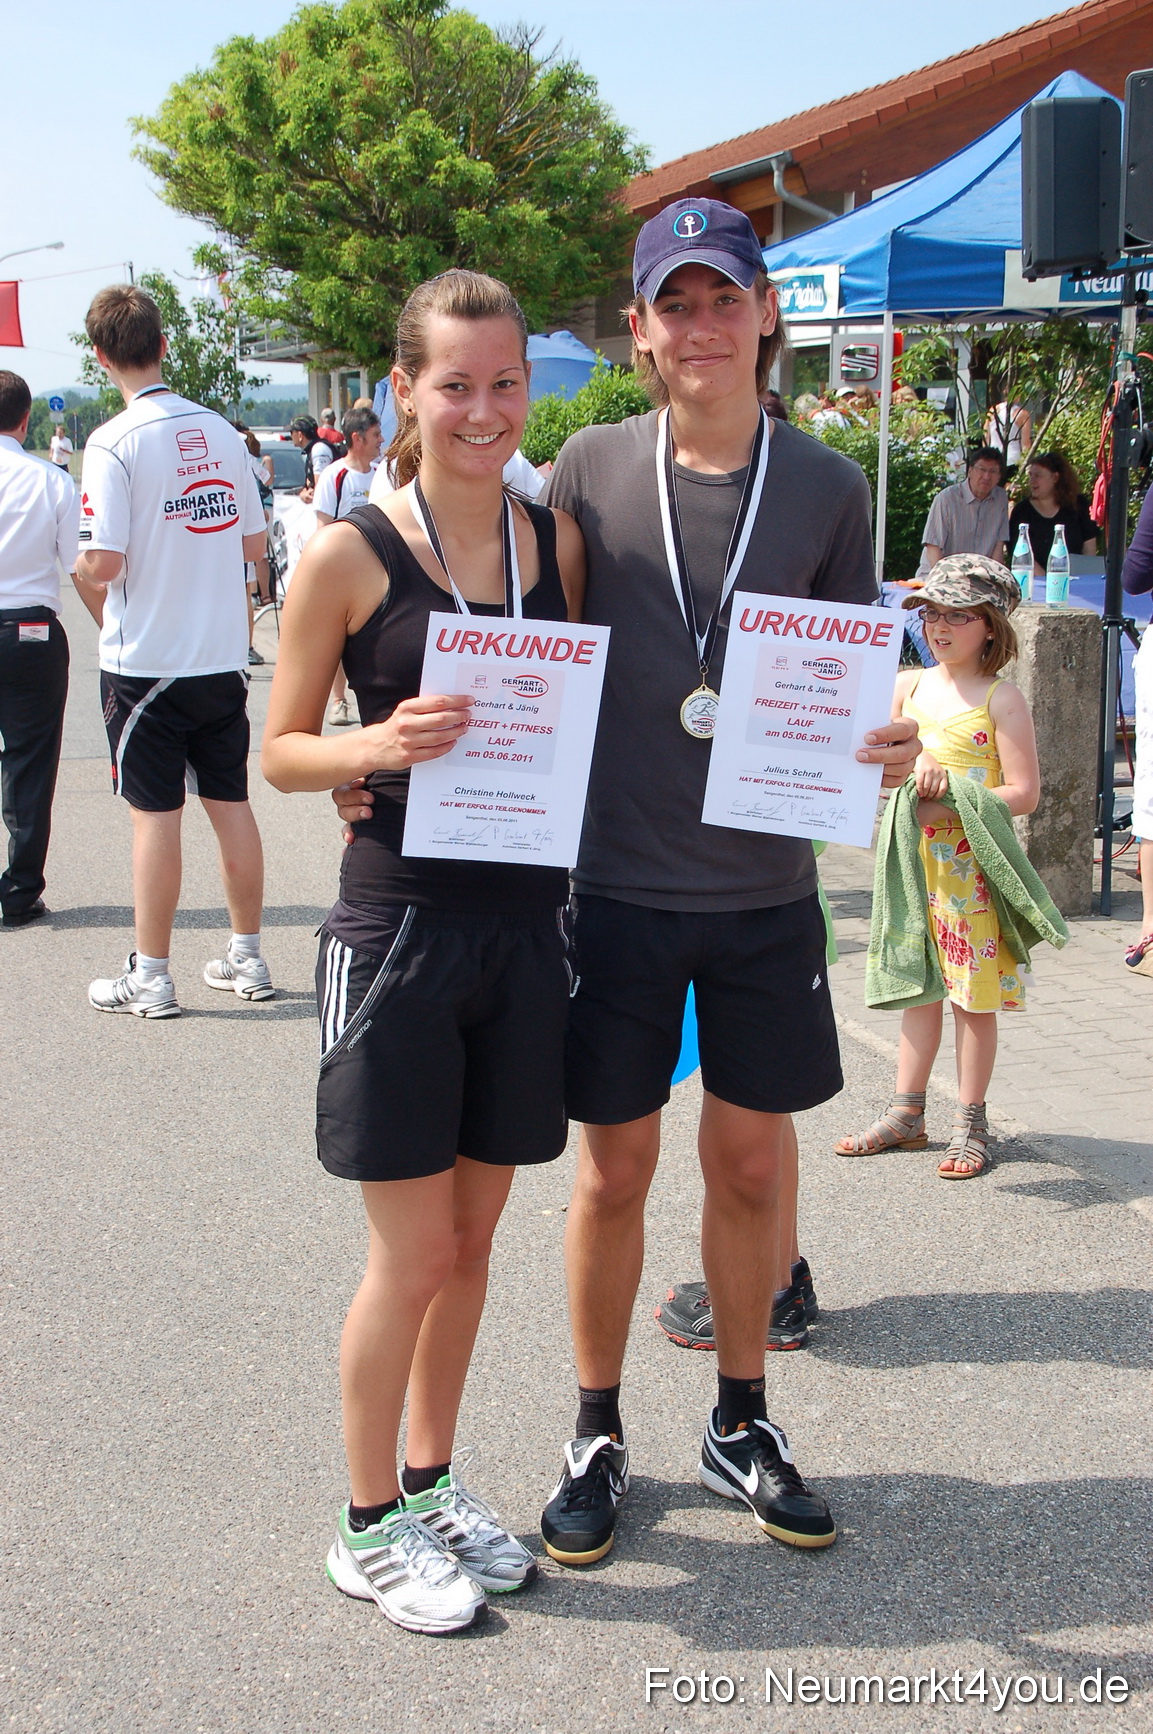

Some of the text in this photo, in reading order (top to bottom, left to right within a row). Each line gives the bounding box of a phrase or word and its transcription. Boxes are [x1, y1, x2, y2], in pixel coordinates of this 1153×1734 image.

[177, 461, 222, 476] SEAT
[164, 491, 235, 513] GERHART &
[165, 511, 192, 520] AUTOHAUS
[739, 608, 894, 647] URKUNDE
[435, 628, 598, 664] URKUNDE
[802, 660, 839, 669] GERHART
[501, 678, 540, 687] GERHART
[774, 681, 806, 692] Gerhart
[815, 686, 838, 696] Jänig
[474, 700, 506, 710] Gerhart
[516, 704, 540, 714] Jänig
[754, 697, 800, 710] FREIZEIT
[809, 705, 852, 717] FITNESS
[510, 723, 553, 735] FITNESS
[787, 717, 815, 728] LAUF
[487, 736, 516, 747] LAUF
[782, 731, 832, 744] 05.06.2011
[465, 750, 533, 763] am 05.06.2011
[763, 765, 790, 775] Julius
[765, 779, 791, 788] ERFOLG
[792, 783, 843, 794] TEILGENOMMEN
[454, 786, 536, 801] Christine Hollweck
[466, 803, 493, 811] ERFOLG
[495, 805, 546, 815] TEILGENOMMEN
